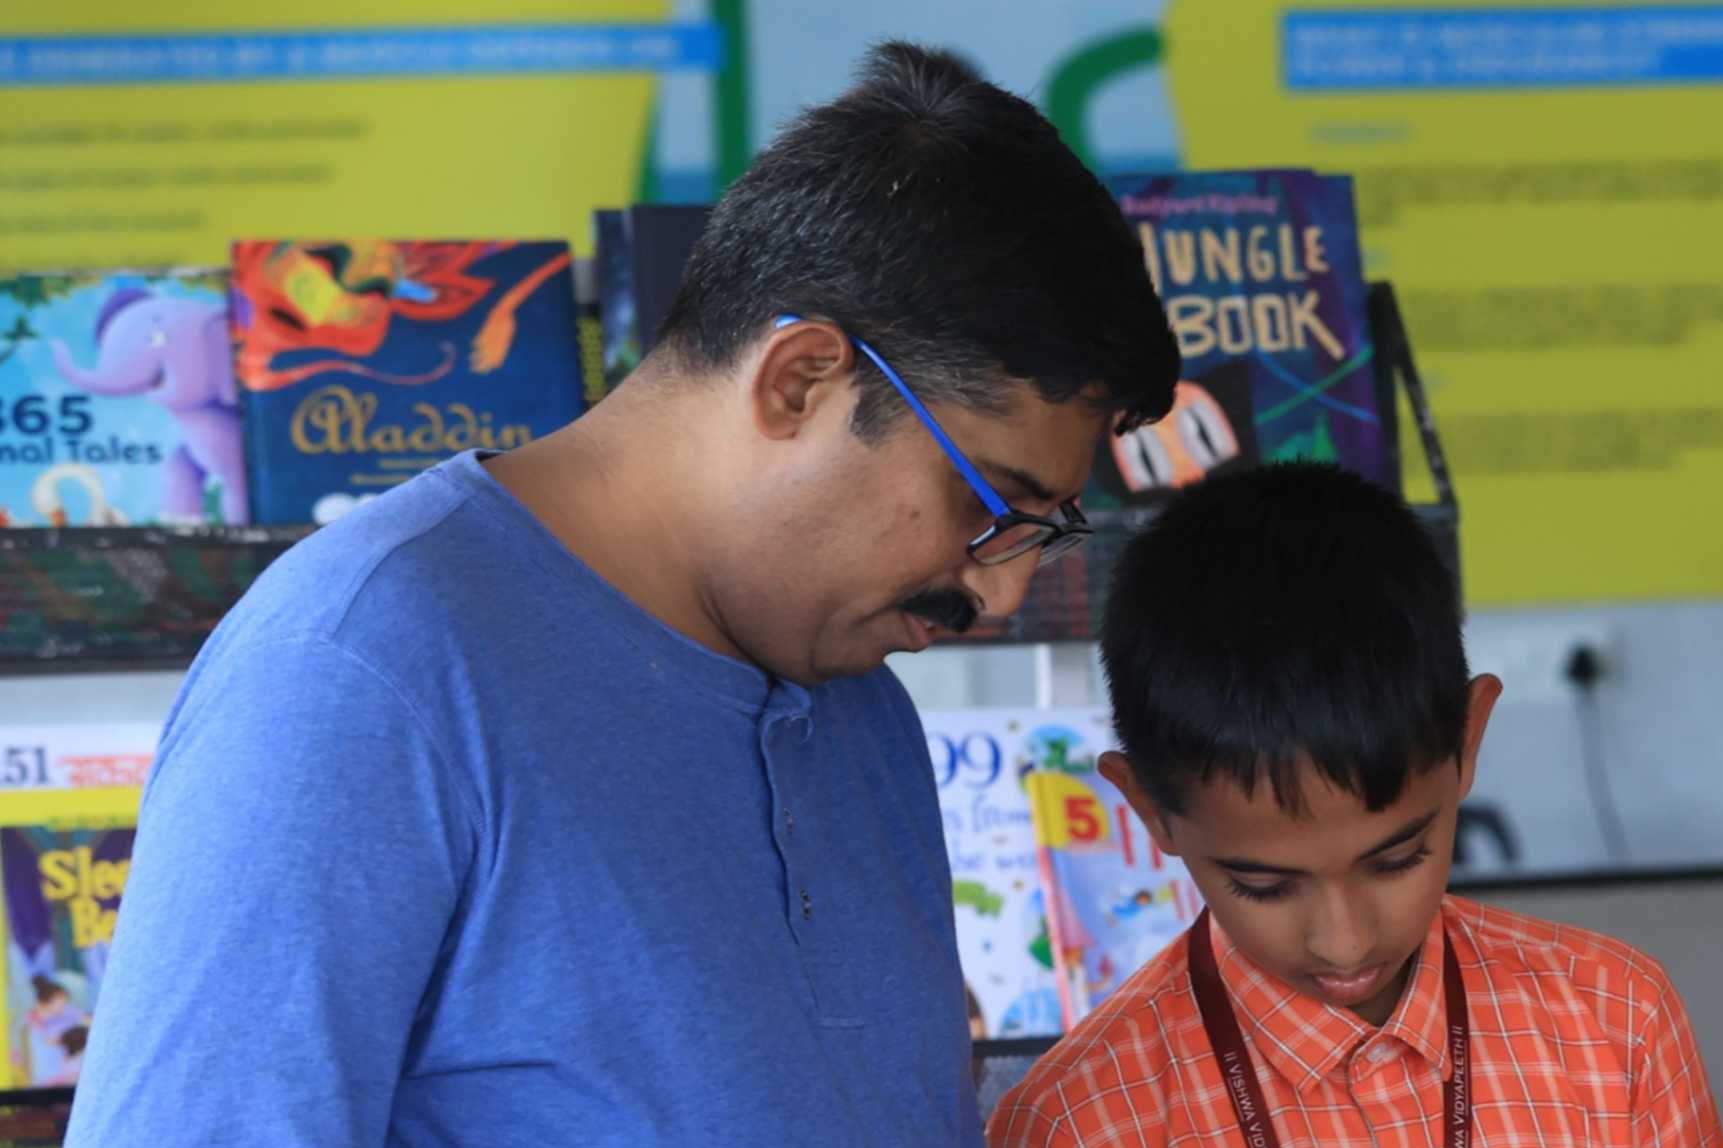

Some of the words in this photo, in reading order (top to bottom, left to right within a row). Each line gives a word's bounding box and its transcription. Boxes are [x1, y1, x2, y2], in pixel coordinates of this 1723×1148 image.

[1166, 289, 1345, 360] BOOK
[66, 437, 162, 464] Tales
[291, 385, 532, 455] Aladdin
[1230, 1065, 1257, 1122] VISHWA
[1453, 1038, 1467, 1124] VIDYAPEETH
